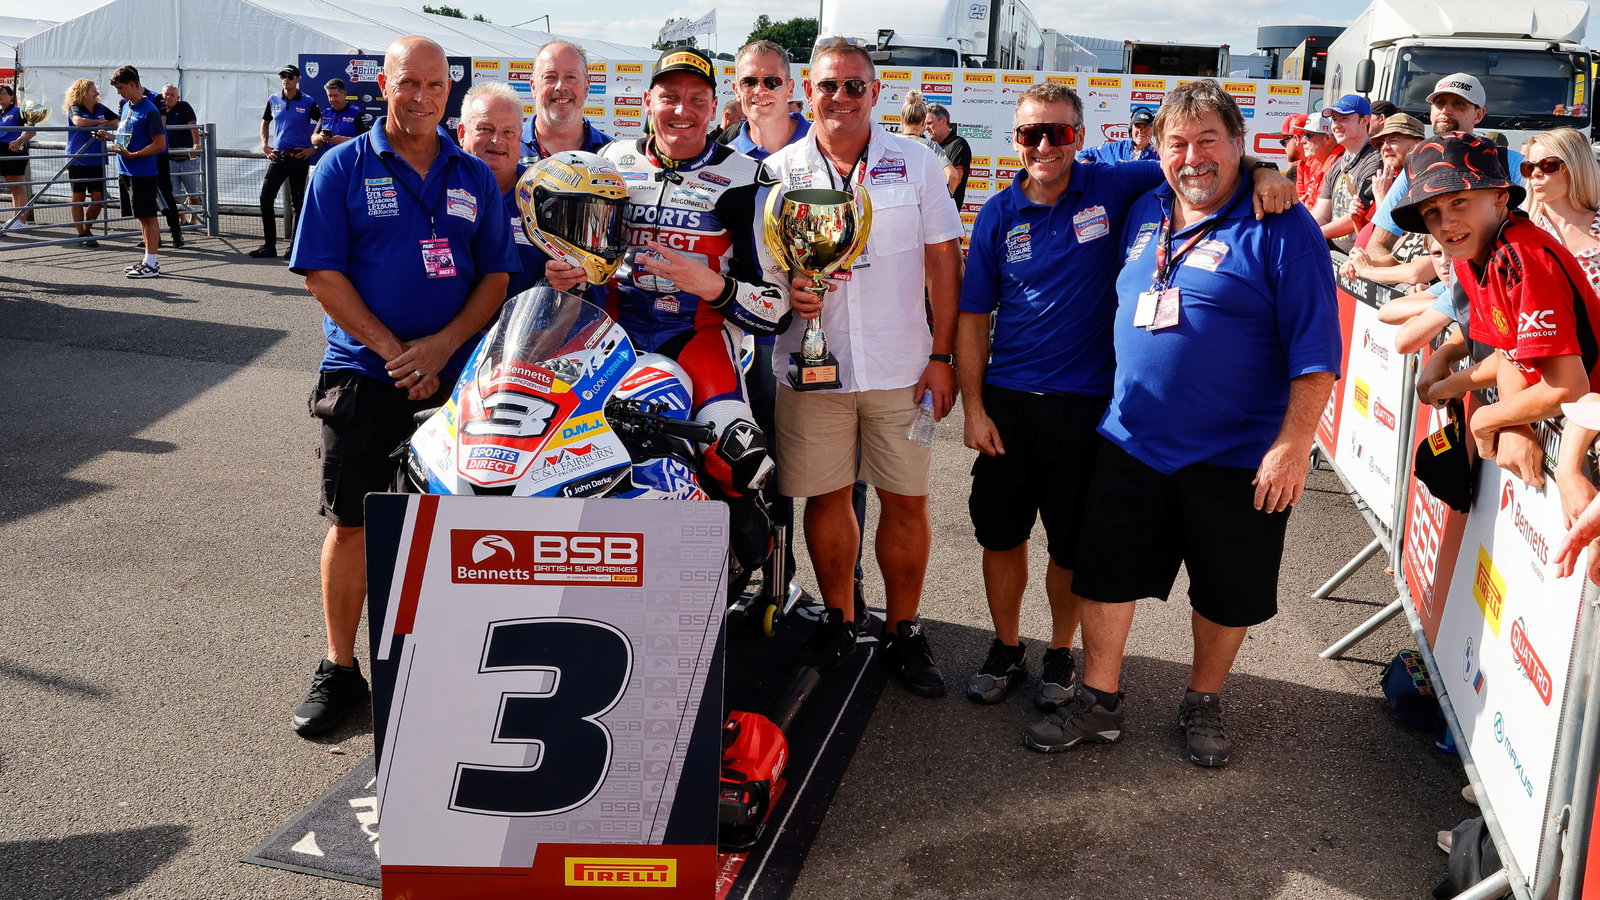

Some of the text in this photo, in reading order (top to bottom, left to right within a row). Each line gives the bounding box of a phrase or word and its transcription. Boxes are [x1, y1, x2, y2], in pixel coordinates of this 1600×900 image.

[475, 61, 499, 69] PIRELLI
[617, 64, 641, 72] PIRELLI
[665, 55, 708, 72] PIRELLI
[883, 71, 909, 79] PIRELLI
[965, 74, 993, 82] PIRELLI
[1004, 75, 1032, 83] PIRELLI
[1091, 79, 1119, 87] PIRELLI
[1135, 80, 1163, 88] PIRELLI
[1225, 84, 1254, 92] PIRELLI
[1270, 86, 1300, 94] PIRELLI
[368, 201, 399, 210] LEISURE
[671, 197, 710, 210] McCONNELL
[1518, 330, 1557, 340] CHNOLOGY
[505, 364, 551, 384] Bennetts
[590, 378, 607, 395] LOOK
[603, 349, 628, 379] FORWARD
[461, 389, 560, 438] 3
[562, 419, 604, 439] D.M.J.
[471, 447, 516, 461] SPORTS
[468, 460, 513, 473] DIRECT
[531, 471, 540, 481] C
[561, 448, 614, 471] FAIRBURN
[574, 476, 612, 494] John Darke
[681, 525, 724, 537] BSB
[1514, 502, 1549, 566] Bennetts
[534, 535, 639, 565] BSB
[457, 566, 530, 581] Bennetts
[574, 565, 638, 573] SUPERBIKES
[1476, 561, 1502, 620] PIRELLI
[679, 614, 720, 626] BSB
[1512, 626, 1550, 698] QUATTRO
[448, 617, 633, 817] 3
[1504, 736, 1533, 798] MAXUS
[600, 801, 641, 813] BSB
[600, 821, 641, 832] BSB
[573, 863, 669, 883] PIRELLI
